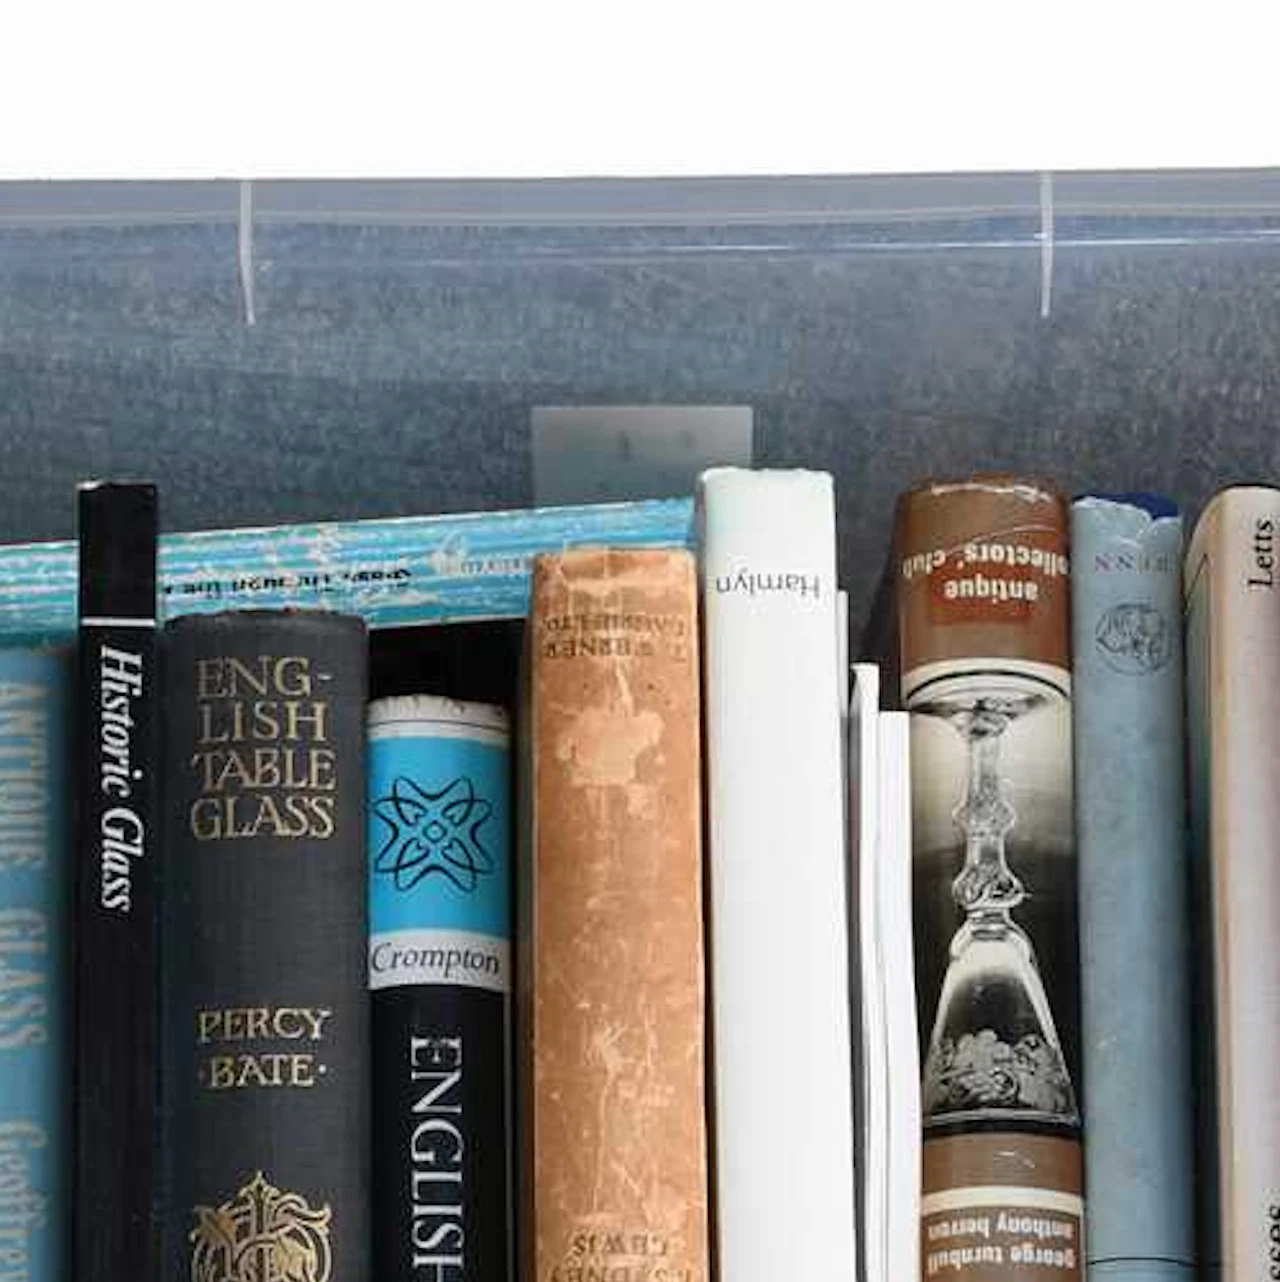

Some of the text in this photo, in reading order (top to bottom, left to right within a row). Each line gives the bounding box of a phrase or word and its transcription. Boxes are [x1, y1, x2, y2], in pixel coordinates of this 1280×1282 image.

[1249, 519, 1275, 587] Letts
[716, 574, 822, 598] Hamlyn
[944, 574, 1038, 603] antique
[198, 657, 332, 698] ENG-
[201, 704, 326, 741] LISH
[100, 645, 145, 912] Historic Glass
[193, 750, 337, 791] TABLE
[191, 798, 335, 841] GLASS
[372, 941, 501, 976] Crompton
[199, 1009, 332, 1041] PERCY
[998, 1213, 1074, 1239] anthony
[928, 1245, 1075, 1273] george turnbull
